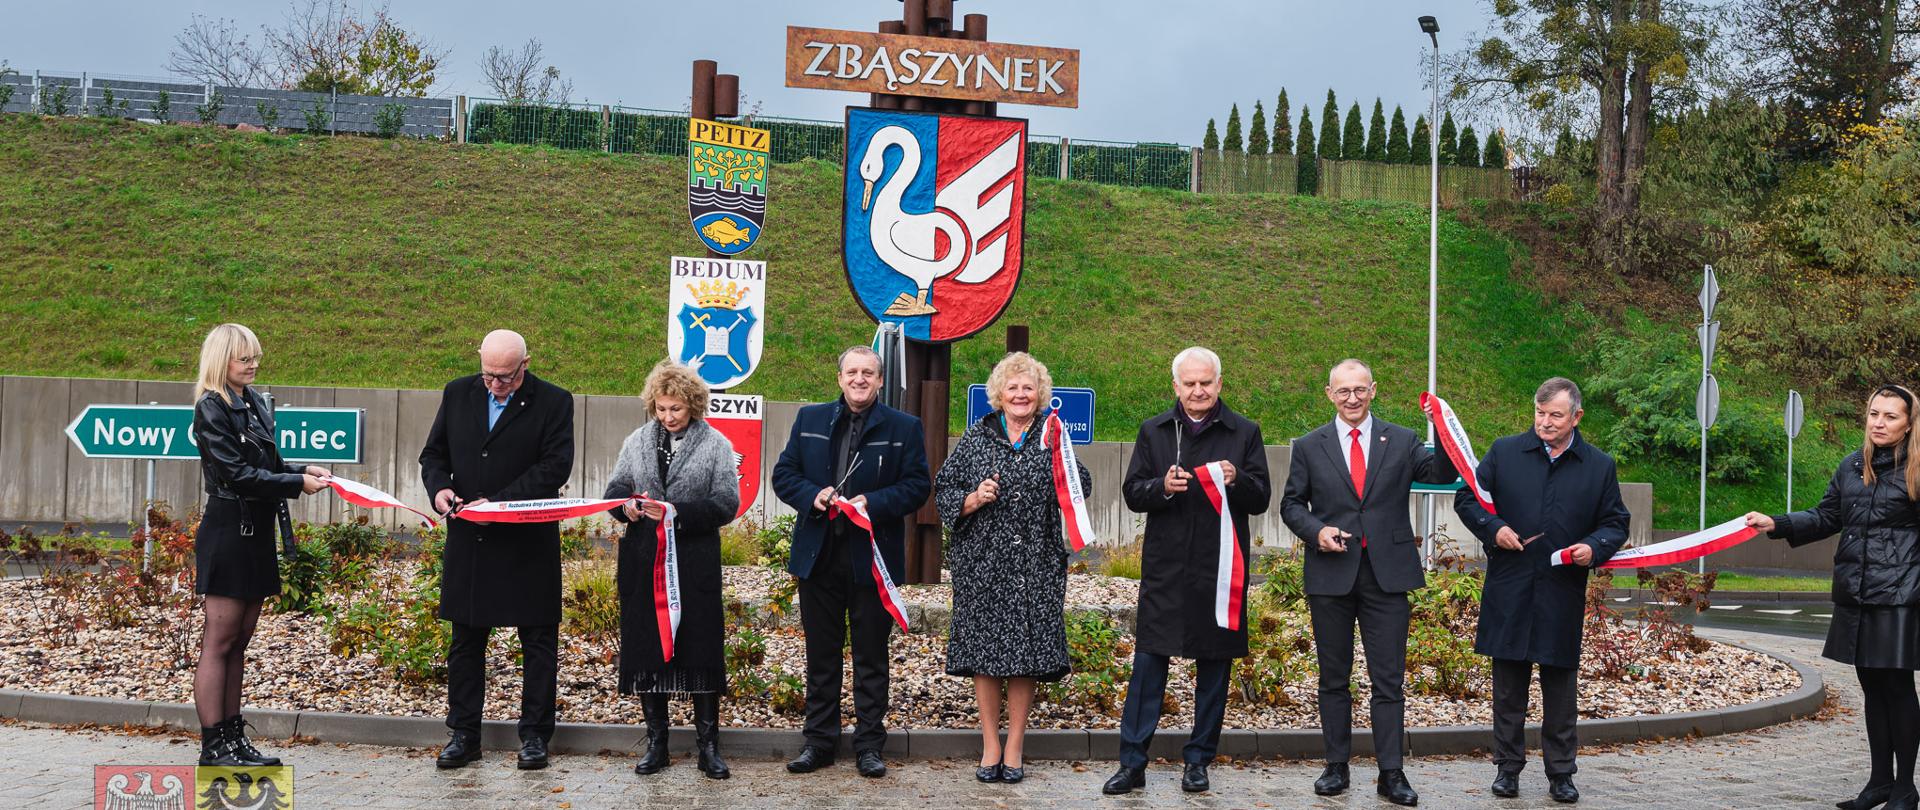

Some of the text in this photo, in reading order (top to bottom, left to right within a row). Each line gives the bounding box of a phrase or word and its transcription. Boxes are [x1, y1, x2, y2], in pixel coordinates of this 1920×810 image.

[803, 41, 1065, 95] ZBĄSZYNEK
[695, 122, 766, 149] PEITZ
[675, 259, 763, 280] BEDUM
[709, 396, 758, 414] SZYŃ
[93, 418, 176, 454] Nowy
